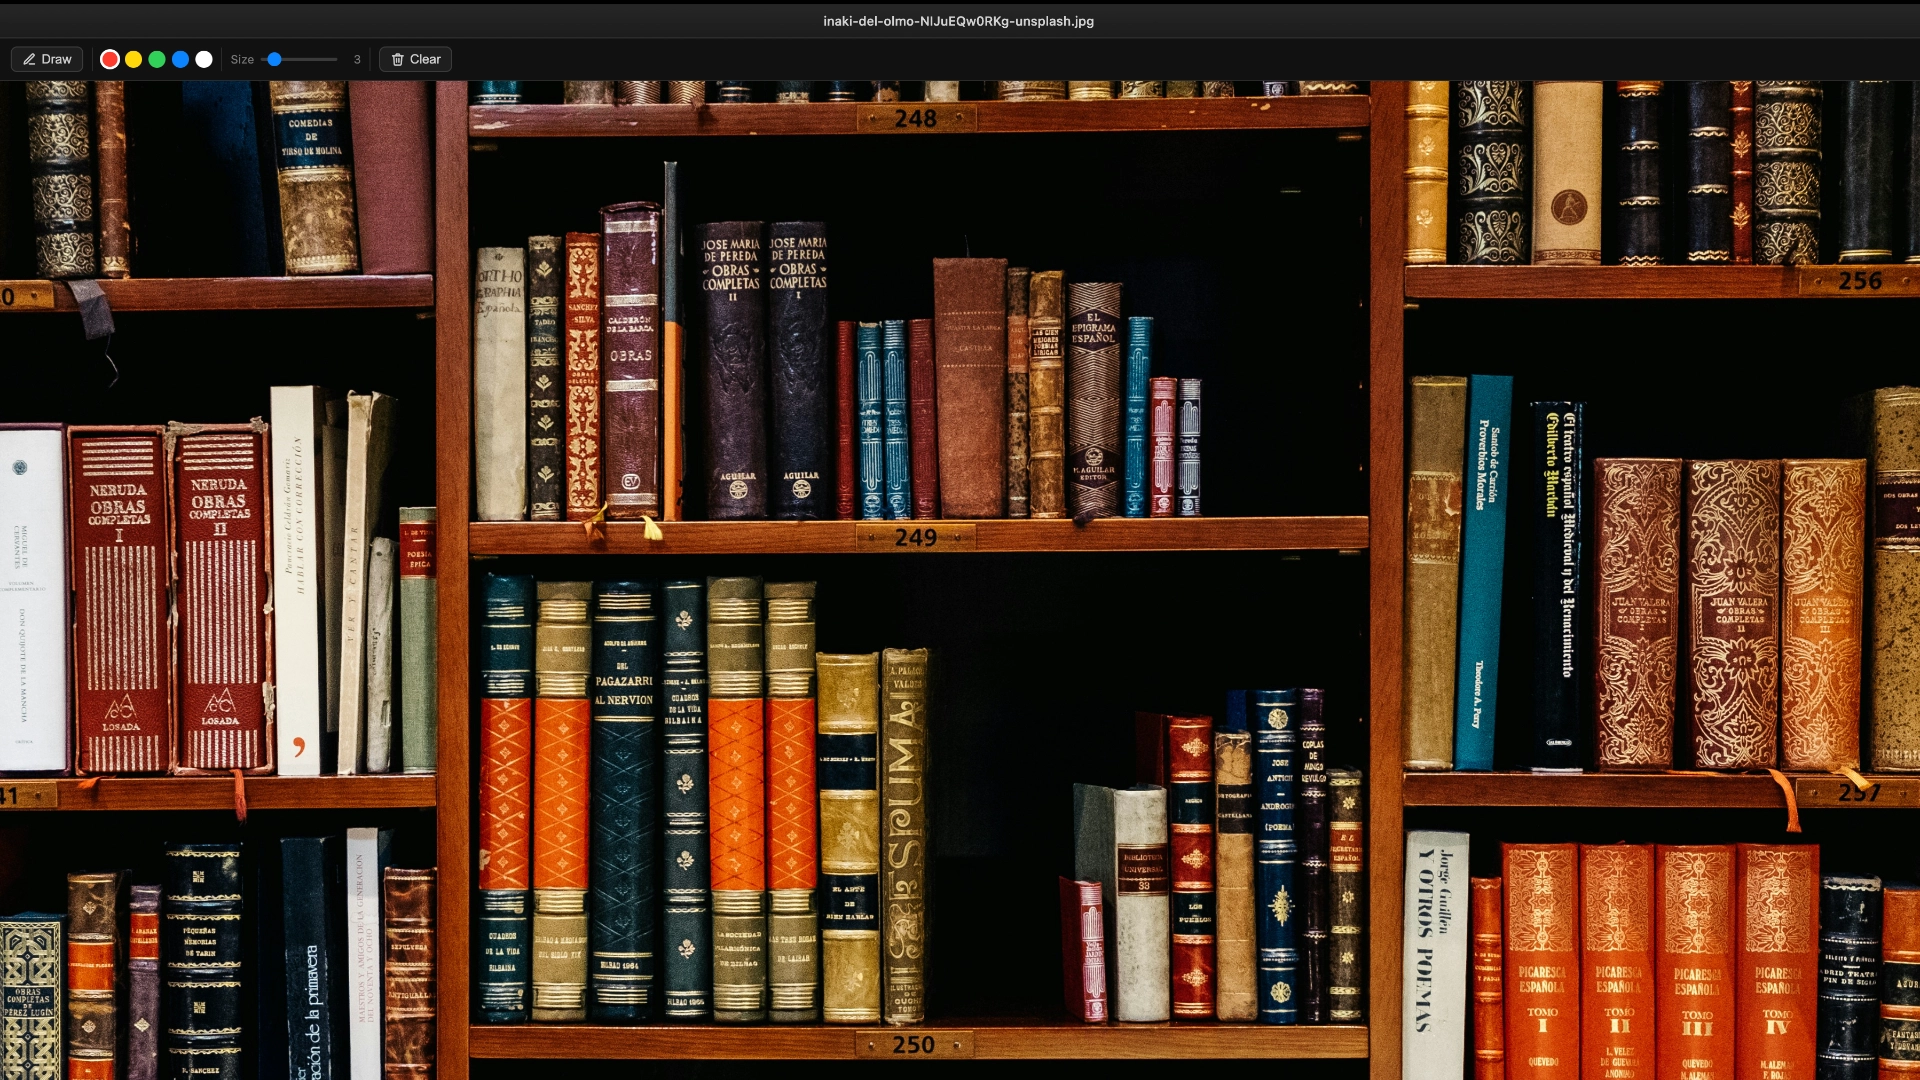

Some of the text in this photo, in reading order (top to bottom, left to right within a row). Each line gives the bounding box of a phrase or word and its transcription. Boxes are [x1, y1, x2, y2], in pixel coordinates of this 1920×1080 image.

[41, 53, 72, 65] Draw
[230, 53, 361, 66] Size 3
[410, 53, 441, 66] Clear
[288, 119, 333, 128] COMEDIAS
[895, 109, 937, 128] 248
[305, 132, 318, 141] DE
[281, 146, 343, 156] TIRSO DE MOLINA
[700, 238, 761, 250] JOSE MARIA
[768, 237, 828, 249] JOSE MARIA
[704, 251, 758, 262] DE PEREDA
[772, 249, 825, 261] DE PEREDA
[711, 264, 750, 277] OBRAS
[779, 263, 817, 275] OBRAS
[478, 270, 522, 283] ORTHO
[770, 276, 827, 289] COMPLETAS
[1838, 271, 1882, 290] 256
[702, 277, 760, 291] COMPLETAS
[728, 293, 737, 301] II
[1087, 313, 1100, 322] EL
[1072, 323, 1116, 333] EPIGRAMA
[1072, 332, 1115, 344] ESPAÑOL
[610, 349, 652, 362] OBRAS
[1475, 419, 1490, 511] Proverbios Morales
[1488, 427, 1500, 503] Santob de Carrión
[720, 472, 757, 481] AGUILAR
[783, 471, 820, 480] AGUILAR
[89, 484, 147, 497] NERUDA
[190, 479, 248, 491] NERUDA
[90, 500, 146, 515] OBRAS
[191, 494, 246, 509] OBRAS
[88, 514, 151, 526] COMPLETAS
[189, 508, 251, 520] COMPLETAS
[292, 436, 305, 595] HABLAR CON CORRECCIÓN
[115, 528, 124, 543] I
[895, 528, 938, 547] 249
[350, 526, 358, 585] CANTAR
[22, 557, 28, 568] DE
[1612, 597, 1671, 607] JUAN VALERA
[1710, 597, 1768, 607] JUAN VALERA
[1794, 598, 1854, 607] JUAN VALERA
[1629, 607, 1658, 615] OBRAS
[1728, 607, 1757, 615] OBRAS
[1811, 607, 1841, 615] OBRAS
[1617, 616, 1667, 624] COMPLETAS
[1715, 615, 1765, 624] COMPLETAS
[1799, 616, 1850, 624] COMPLETAS
[347, 616, 355, 642] VER
[20, 663, 26, 675] DE
[20, 676, 27, 687] LA
[595, 676, 653, 687] PAGAZARRI
[594, 695, 653, 705] AL NERVION
[671, 693, 699, 702] CUADROS
[20, 689, 28, 724] MANCHA
[668, 705, 702, 714] DE LA VIDA
[102, 723, 141, 731] LOSADA
[201, 717, 240, 725] LOSADA
[664, 717, 702, 725] BILBAINA
[1302, 740, 1325, 749] COPLAS
[1309, 751, 1318, 760] DE
[1271, 759, 1289, 767] JOSE
[1304, 762, 1324, 771] MINGO
[1266, 774, 1294, 782] ANTICH
[1838, 783, 1881, 803] 257
[356, 853, 364, 908] GENERACION
[1138, 881, 1150, 890] 33
[1437, 849, 1454, 934] Jorge Guillén
[357, 920, 364, 934] DE
[184, 938, 217, 946] MEMORIAS
[488, 932, 517, 940] CUADROS
[1415, 848, 1435, 1033] Y OTROS POEMAS
[495, 947, 505, 956] LA
[506, 947, 520, 955] VIDA
[304, 945, 324, 1006] primavera
[358, 972, 364, 980] Y
[1518, 966, 1566, 978] PICARESCA
[1595, 966, 1642, 979] PICARESCA
[1674, 967, 1722, 981] PICARESCA
[1755, 966, 1803, 980] PICARESCA
[15, 988, 42, 996] OBRAS
[1519, 980, 1565, 993] ESPAÑOLA
[1596, 980, 1641, 993] ESPAÑOLA
[1674, 982, 1720, 996] ESPAÑOLA
[1755, 981, 1801, 995] ESPAÑOLA
[7, 995, 50, 1003] COMPLETAS
[358, 983, 366, 1023] MAESTROS
[304, 1009, 320, 1020] la
[1527, 1008, 1559, 1017] TOMO
[1604, 1008, 1635, 1017] TOMO
[1682, 1010, 1714, 1020] TOMO
[1762, 1009, 1794, 1019] TOMO
[1538, 1018, 1548, 1033] I
[1609, 1018, 1631, 1034] II
[1681, 1021, 1714, 1037] III
[1766, 1019, 1792, 1035] IV
[304, 1023, 321, 1043] de
[892, 1035, 935, 1054] 250
[1528, 1057, 1559, 1067] QUEVEDO
[1682, 1059, 1713, 1068] QUEVEDO
